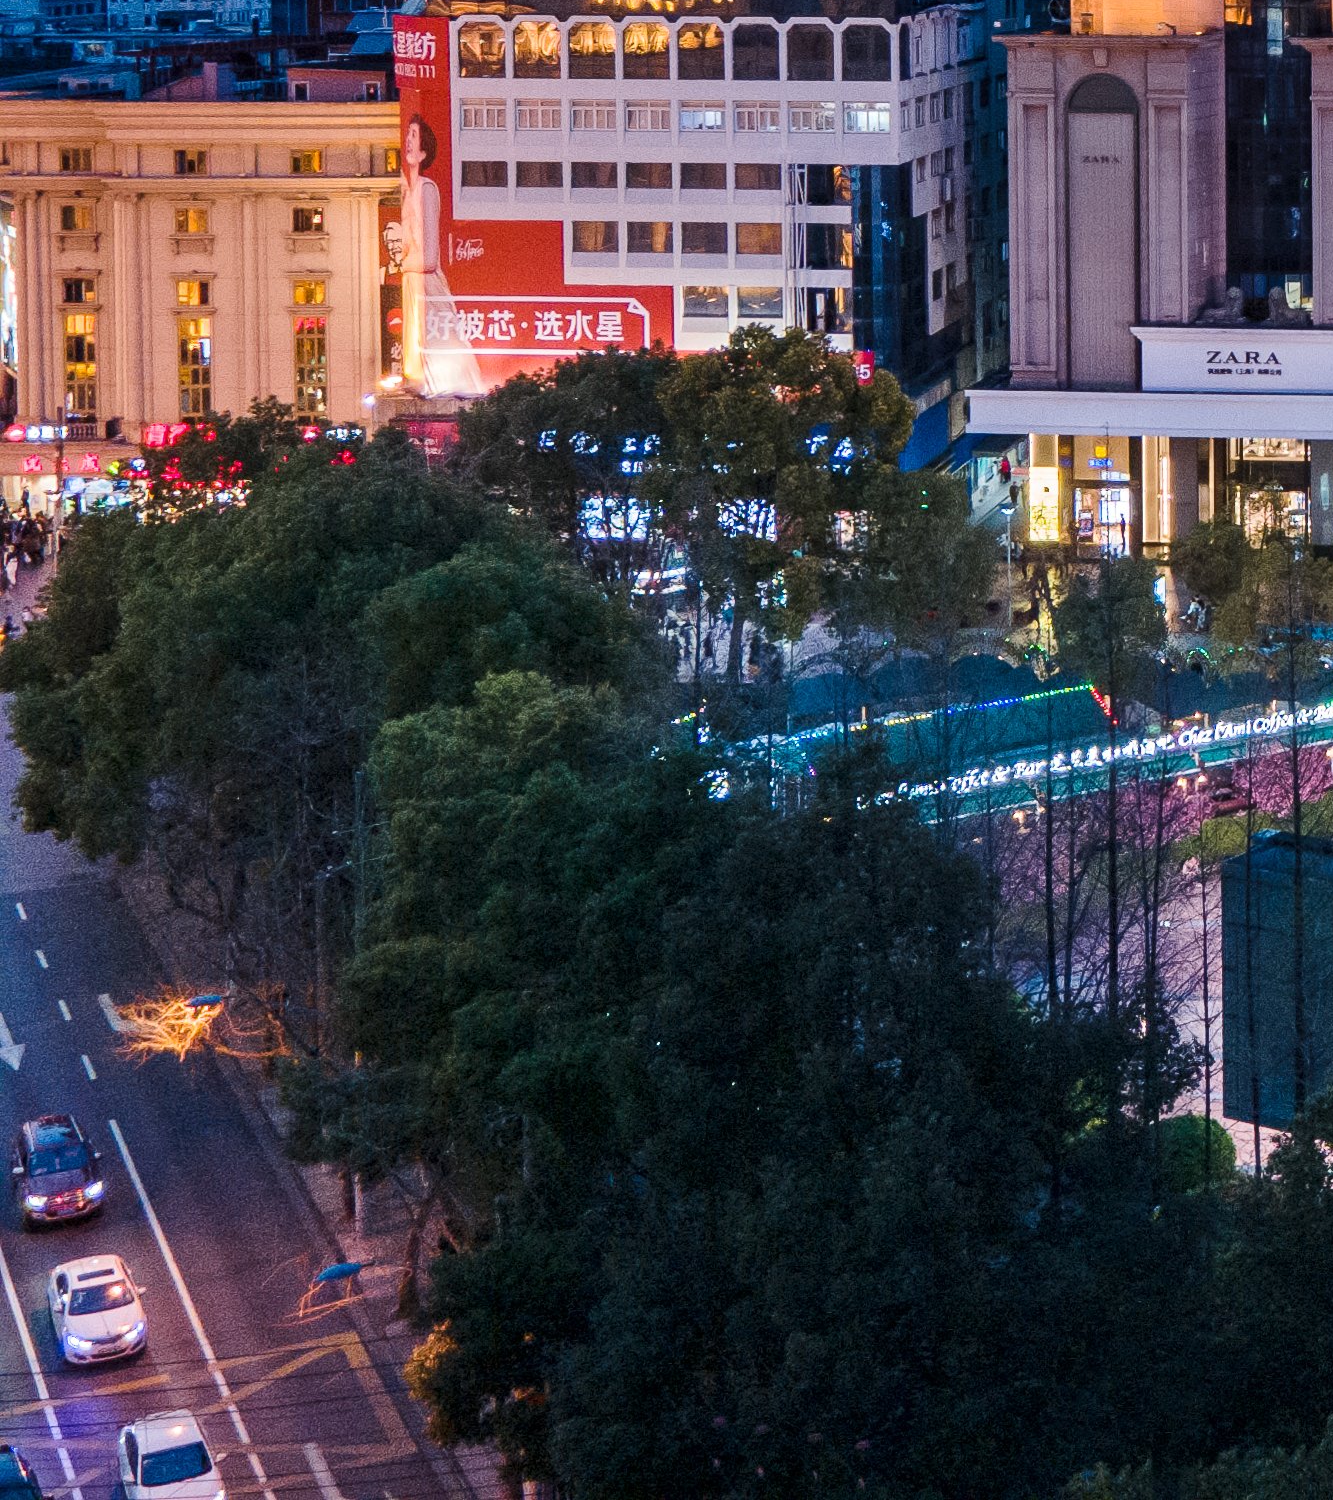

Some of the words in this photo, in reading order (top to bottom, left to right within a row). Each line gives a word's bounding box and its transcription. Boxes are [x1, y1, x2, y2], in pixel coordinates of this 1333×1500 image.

[1081, 155, 1121, 165] ZARA
[1206, 350, 1282, 365] ZARA
[1178, 726, 1212, 747] Chez
[1253, 711, 1294, 735] Coffee
